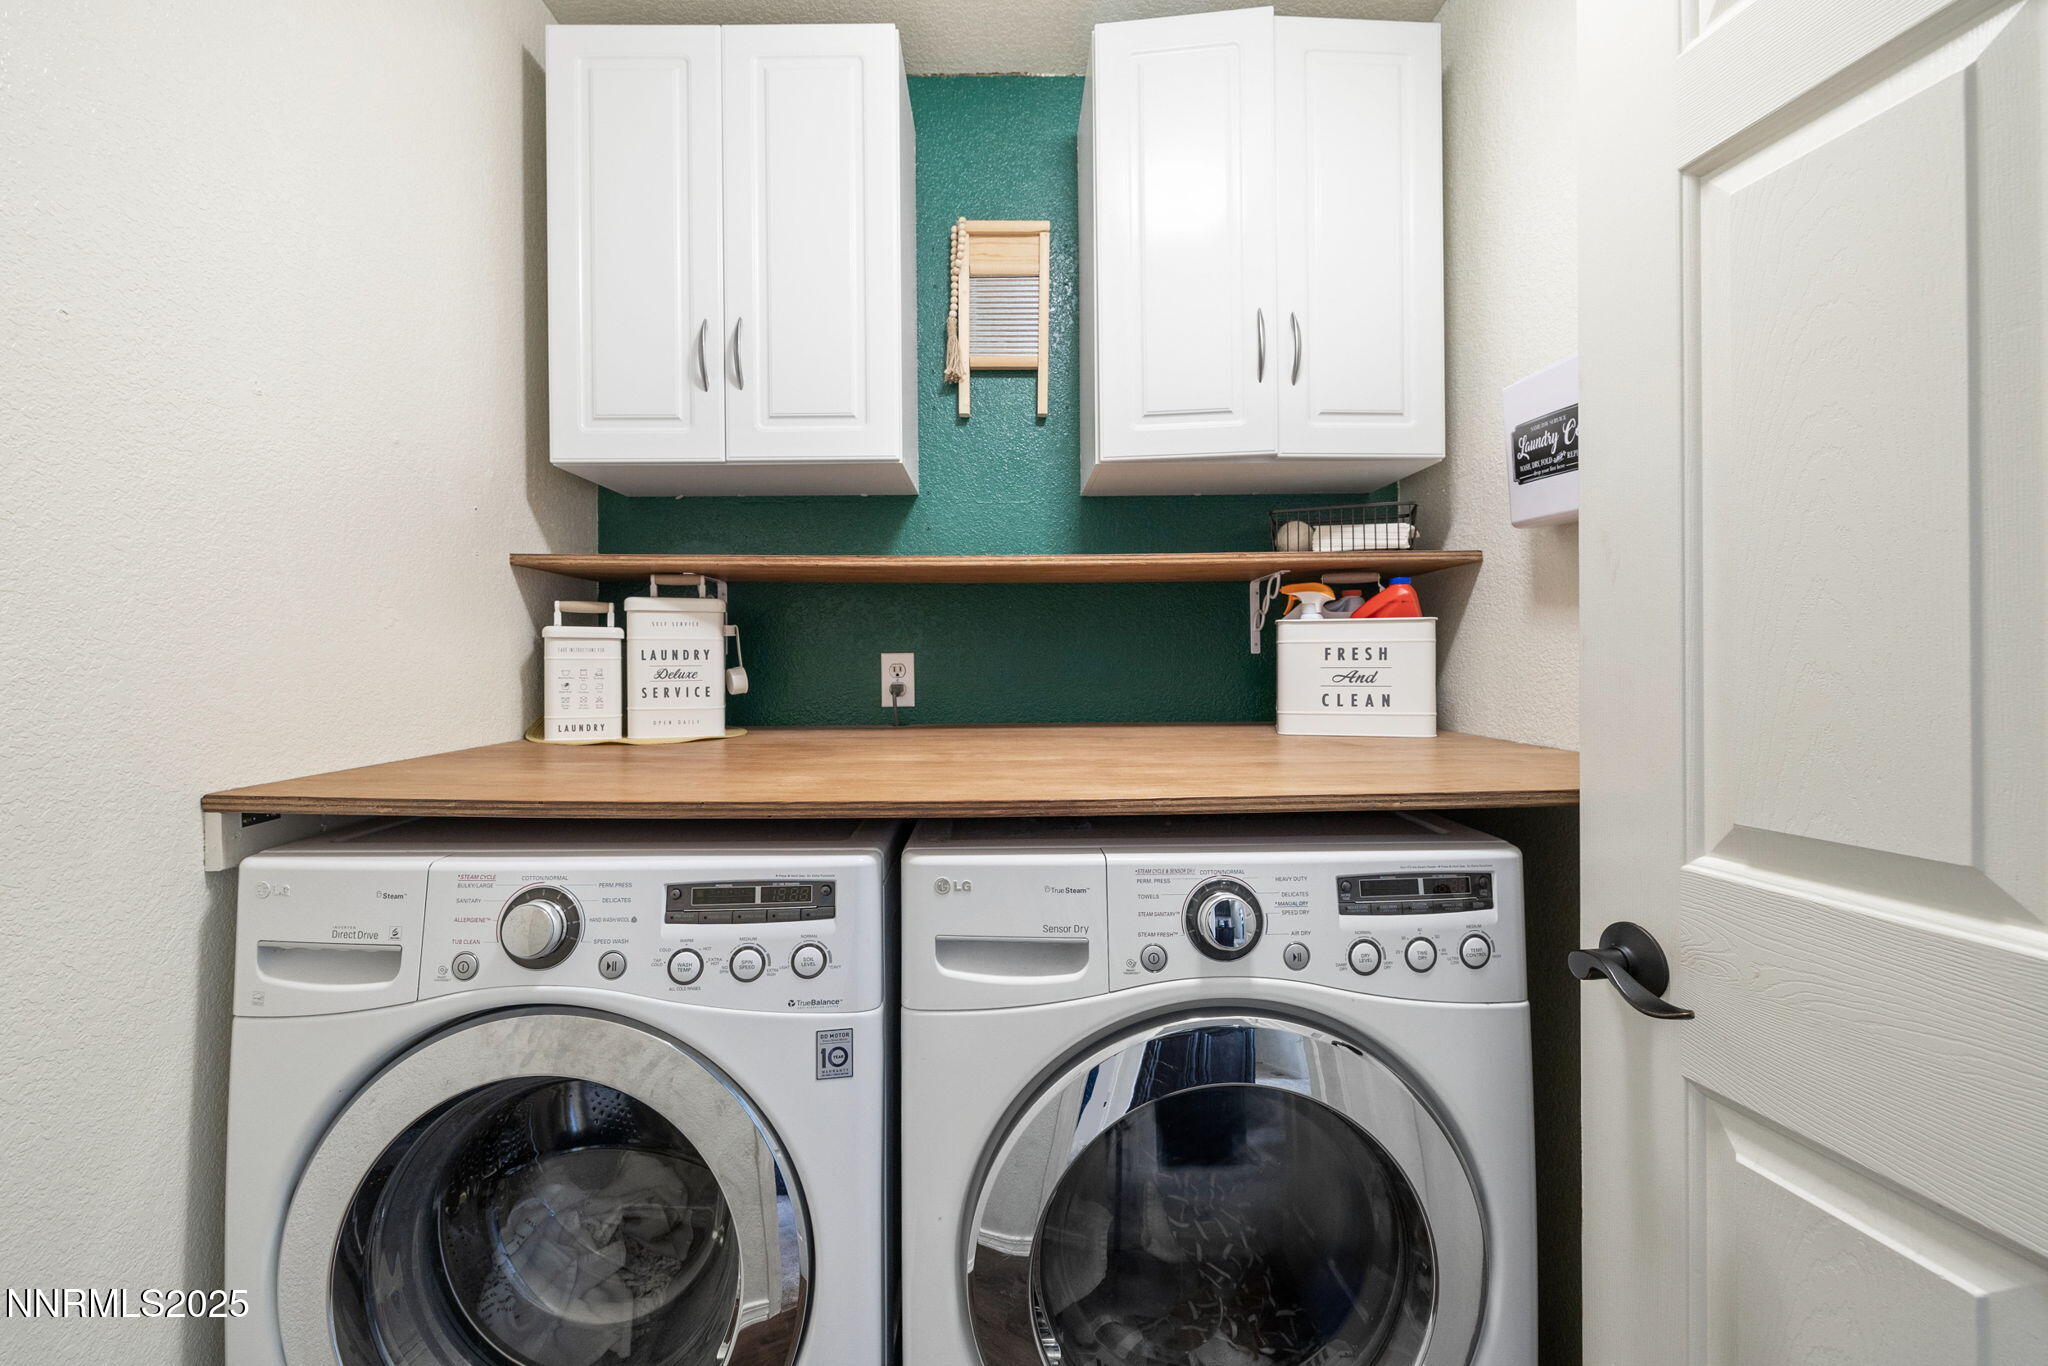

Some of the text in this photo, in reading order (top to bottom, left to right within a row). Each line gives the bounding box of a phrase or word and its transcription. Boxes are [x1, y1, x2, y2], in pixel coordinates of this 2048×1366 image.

[1517, 430, 1559, 460] Laundry
[641, 649, 710, 660] LAUNDRY
[1324, 647, 1387, 661] FRESH
[654, 668, 698, 680] Deluxe
[1332, 670, 1378, 684] And
[642, 686, 711, 698] SERVICE
[1322, 693, 1390, 707] CLEAN
[558, 723, 605, 733] LAUNDRY
[953, 880, 972, 892] LG
[1042, 925, 1089, 935] Sensor Dry
[821, 1046, 848, 1068] 10
